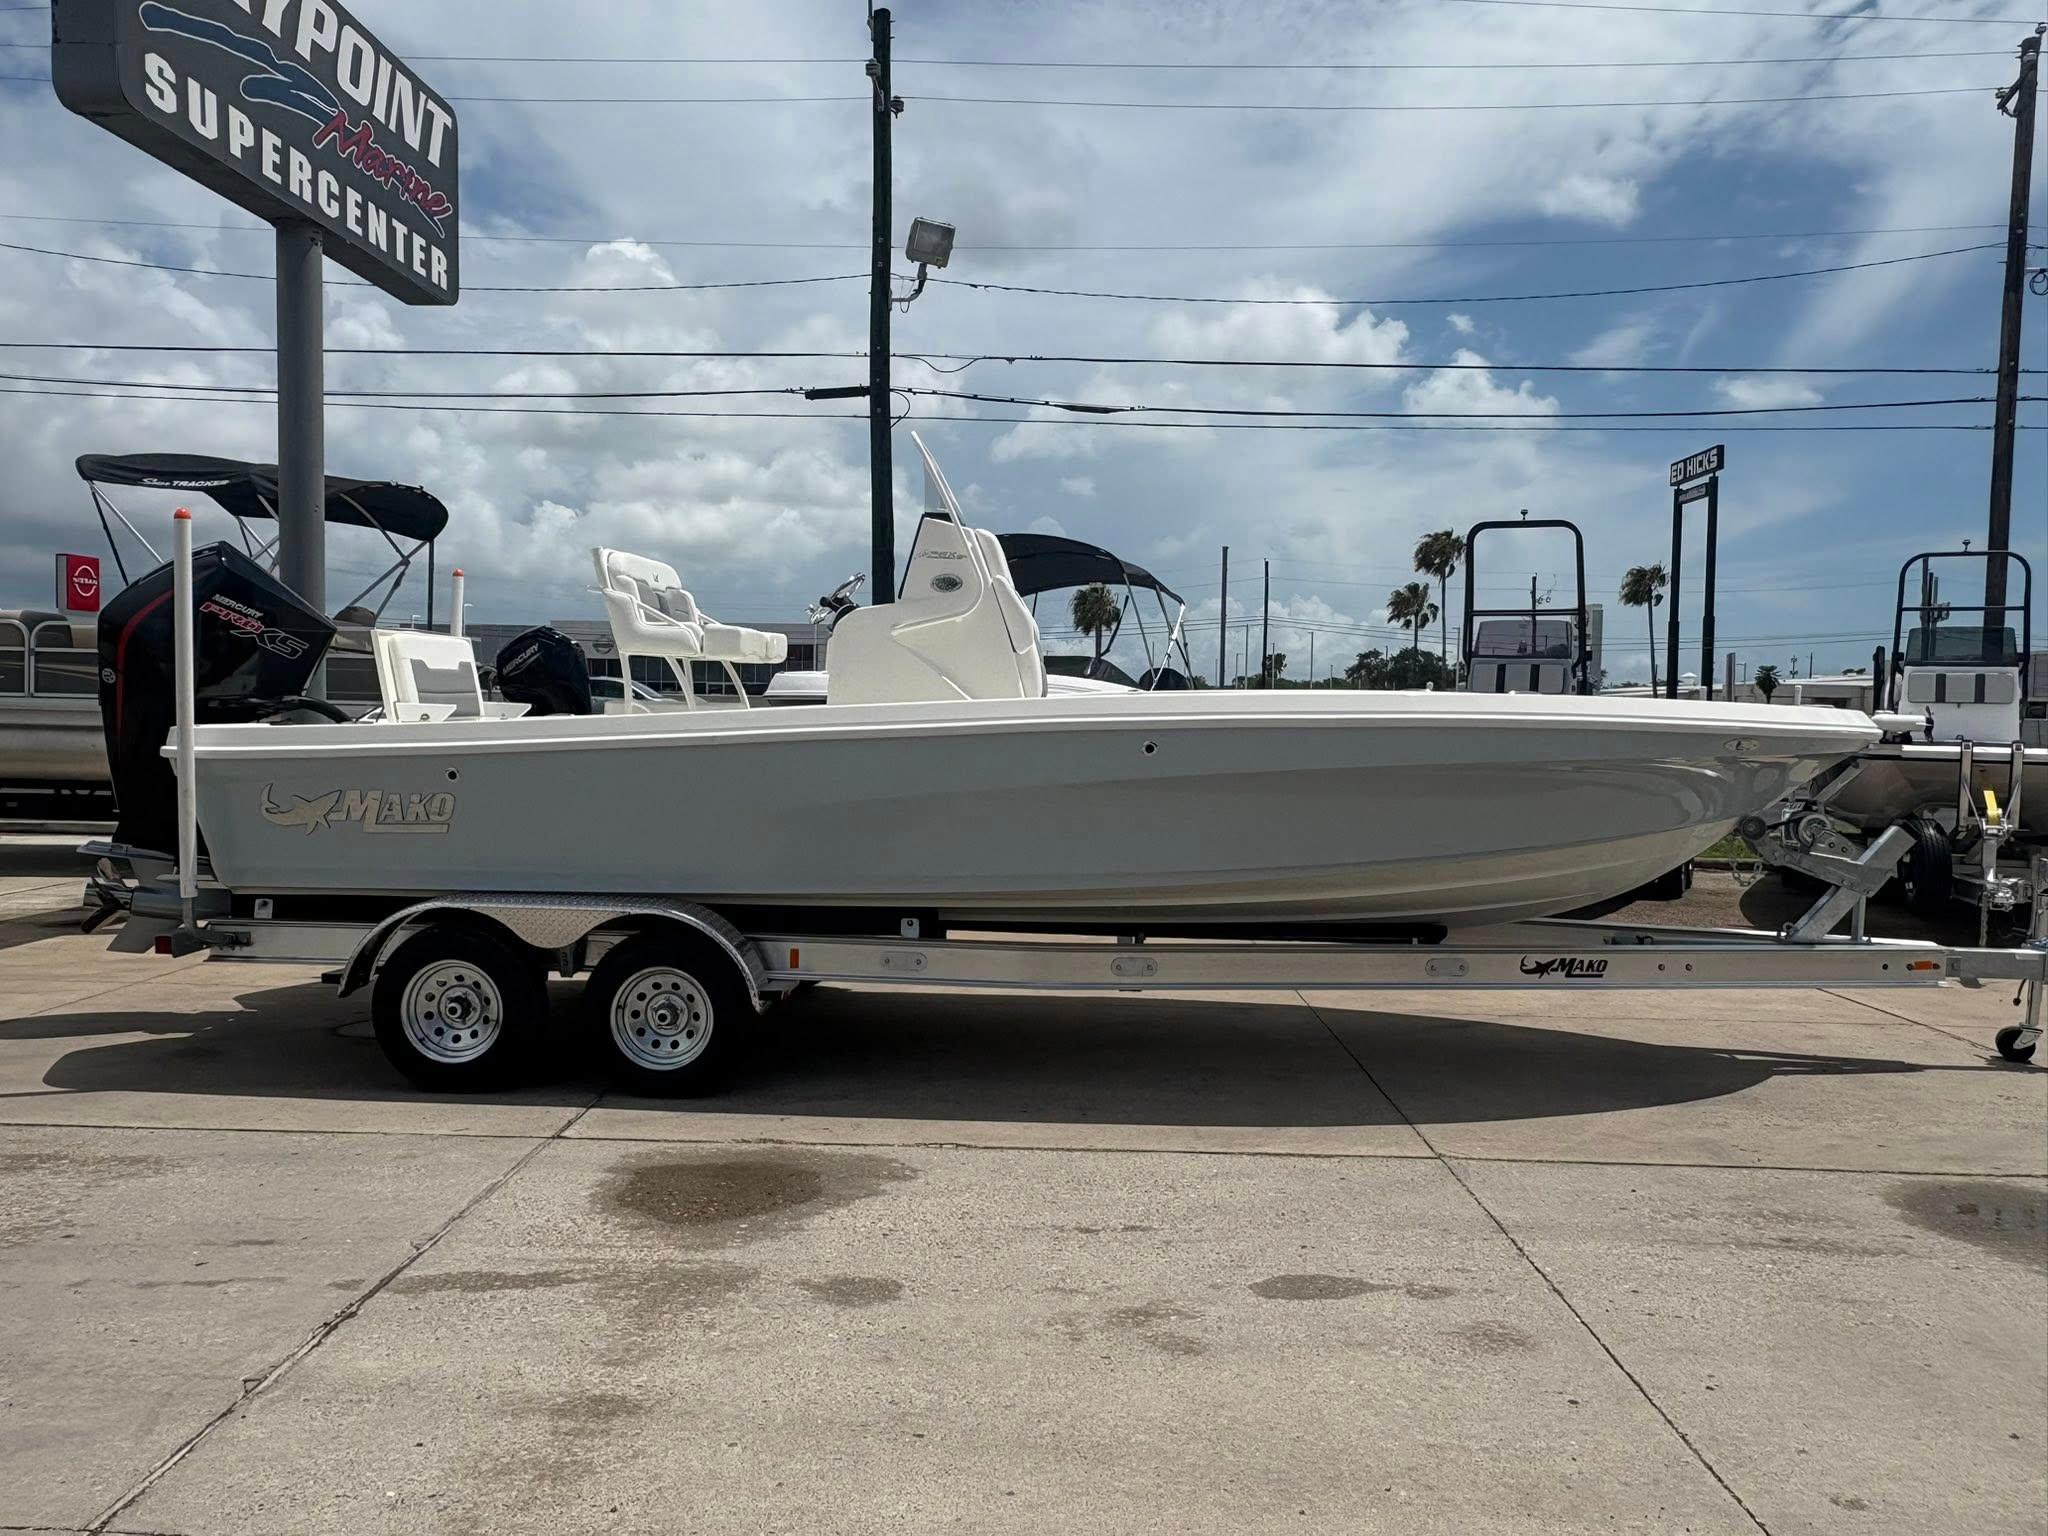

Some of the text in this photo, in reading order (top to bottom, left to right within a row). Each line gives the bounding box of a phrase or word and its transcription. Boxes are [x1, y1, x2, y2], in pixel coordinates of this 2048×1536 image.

[232, 0, 453, 168] YPOINT
[144, 52, 448, 292] SUPERCENTER
[1671, 448, 1718, 483] ED HICKS
[72, 577, 98, 585] NISSAN
[212, 594, 264, 619] MERCURY
[503, 642, 539, 676] MERCURY
[329, 789, 456, 834] MAKO
[1549, 957, 1608, 978] MAKO
